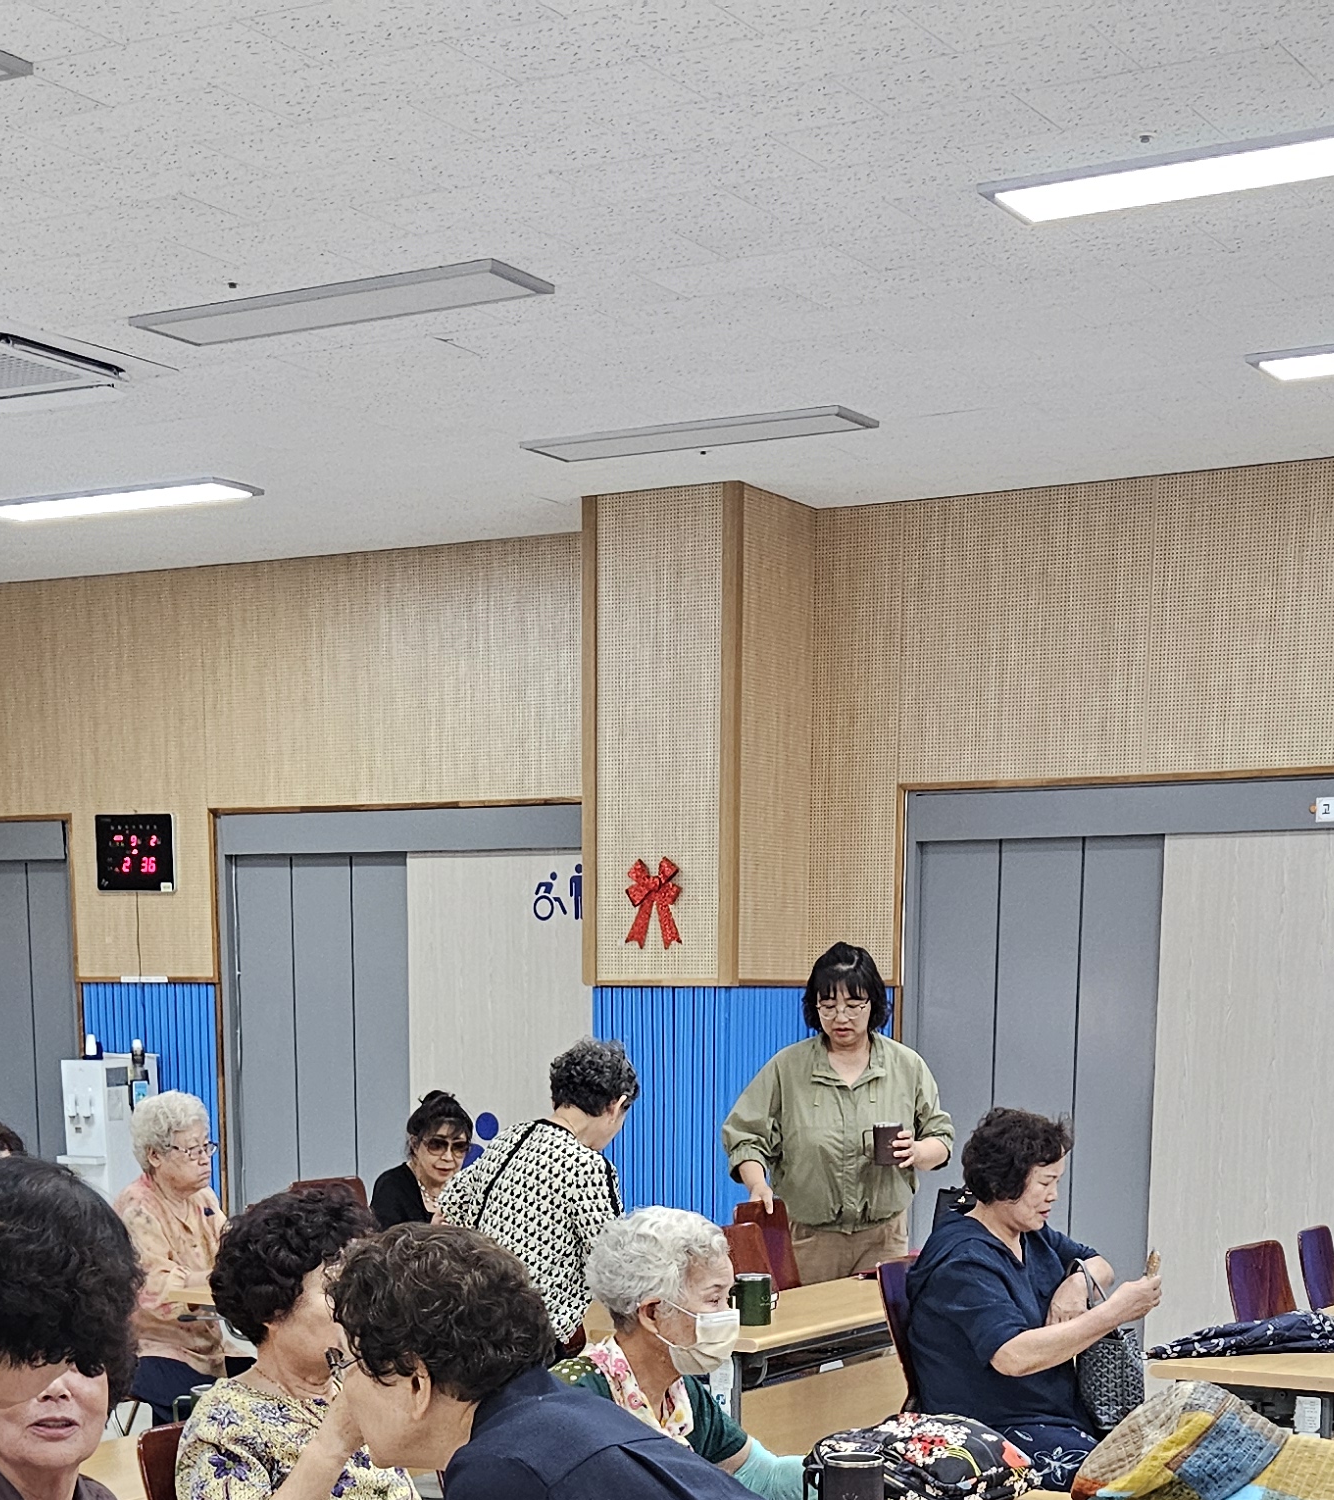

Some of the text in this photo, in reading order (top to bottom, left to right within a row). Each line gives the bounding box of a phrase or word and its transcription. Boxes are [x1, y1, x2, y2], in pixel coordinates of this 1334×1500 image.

[130, 835, 137, 846] 9
[150, 835, 157, 846] 2
[122, 857, 156, 872] 2 36
